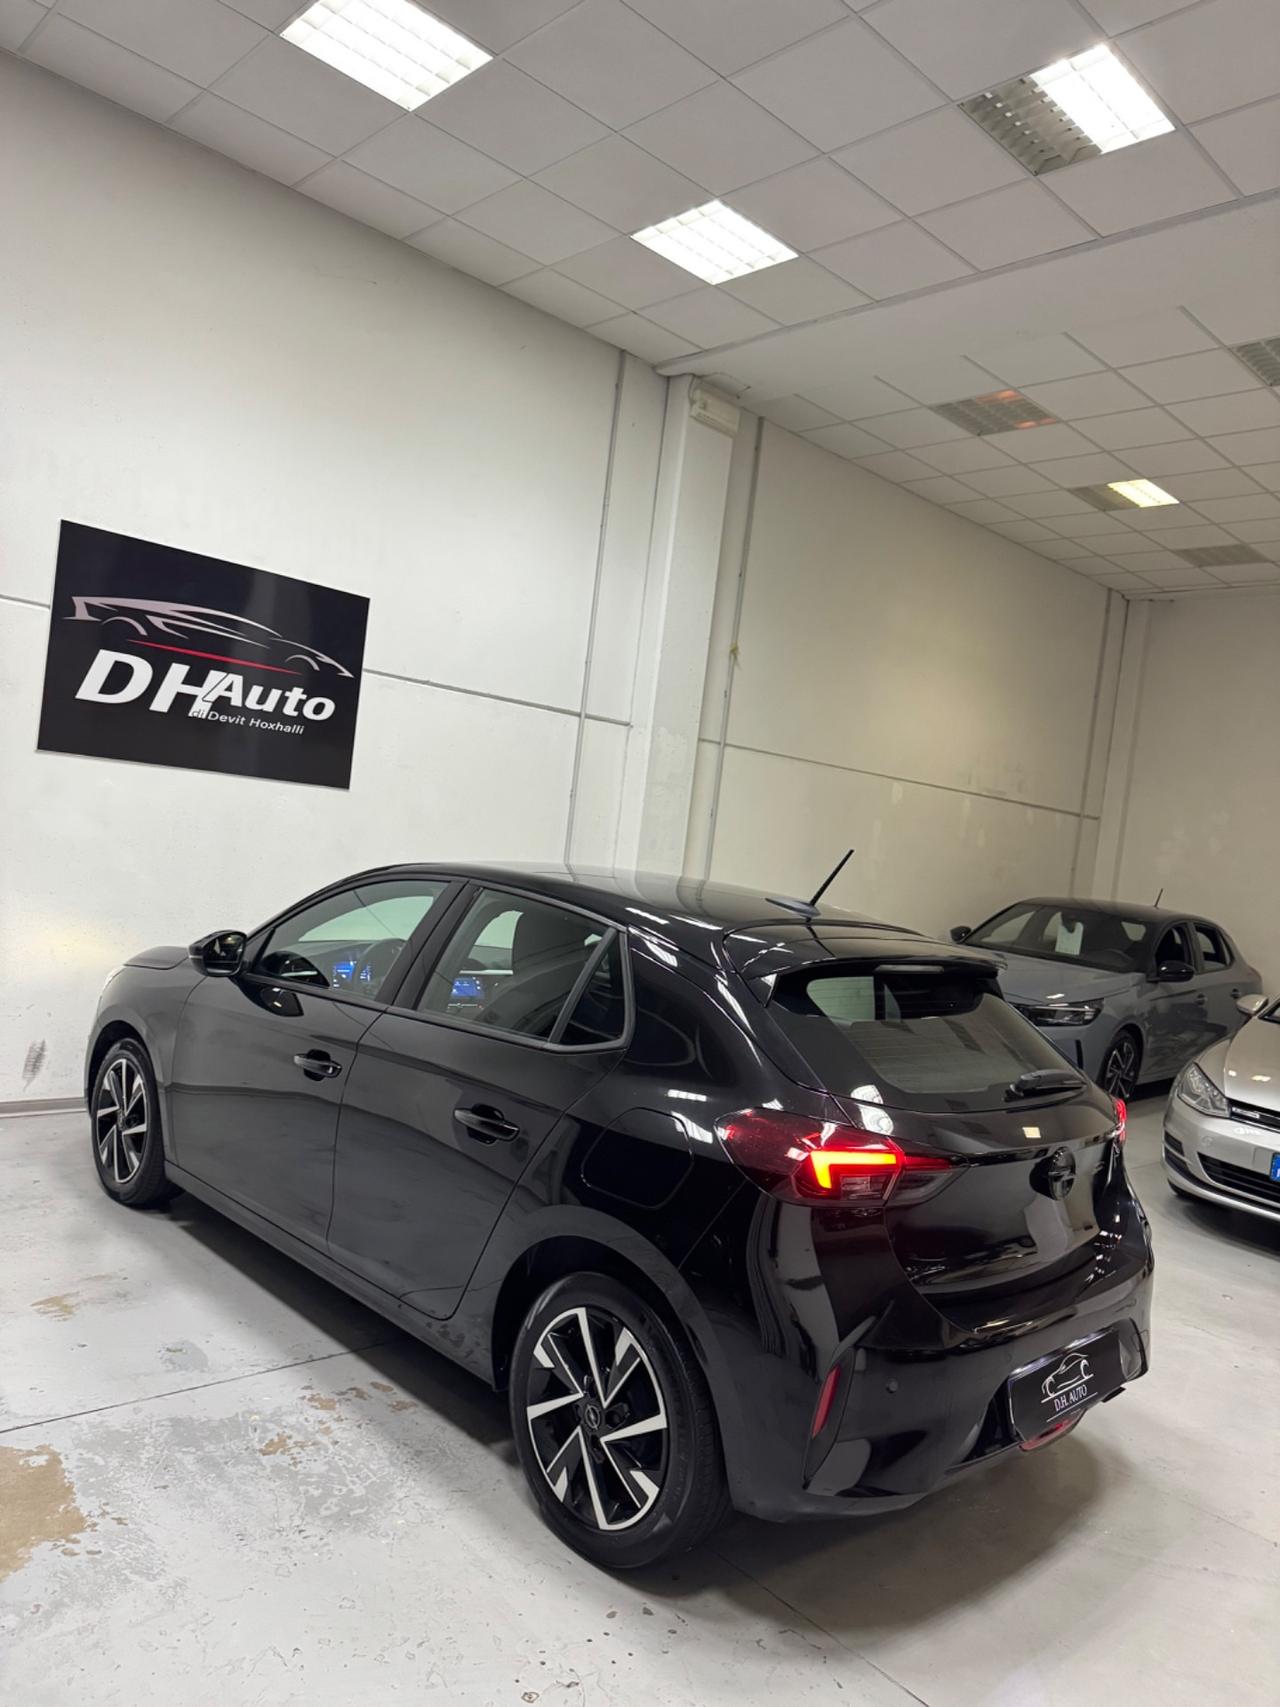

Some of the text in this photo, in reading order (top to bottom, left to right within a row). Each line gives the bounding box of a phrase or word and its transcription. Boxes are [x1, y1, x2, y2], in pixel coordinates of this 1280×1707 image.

[202, 673, 336, 721] Auto
[207, 711, 247, 726] Devit
[249, 718, 305, 735] Hoxhalli
[1069, 1384, 1088, 1404] AUTO
